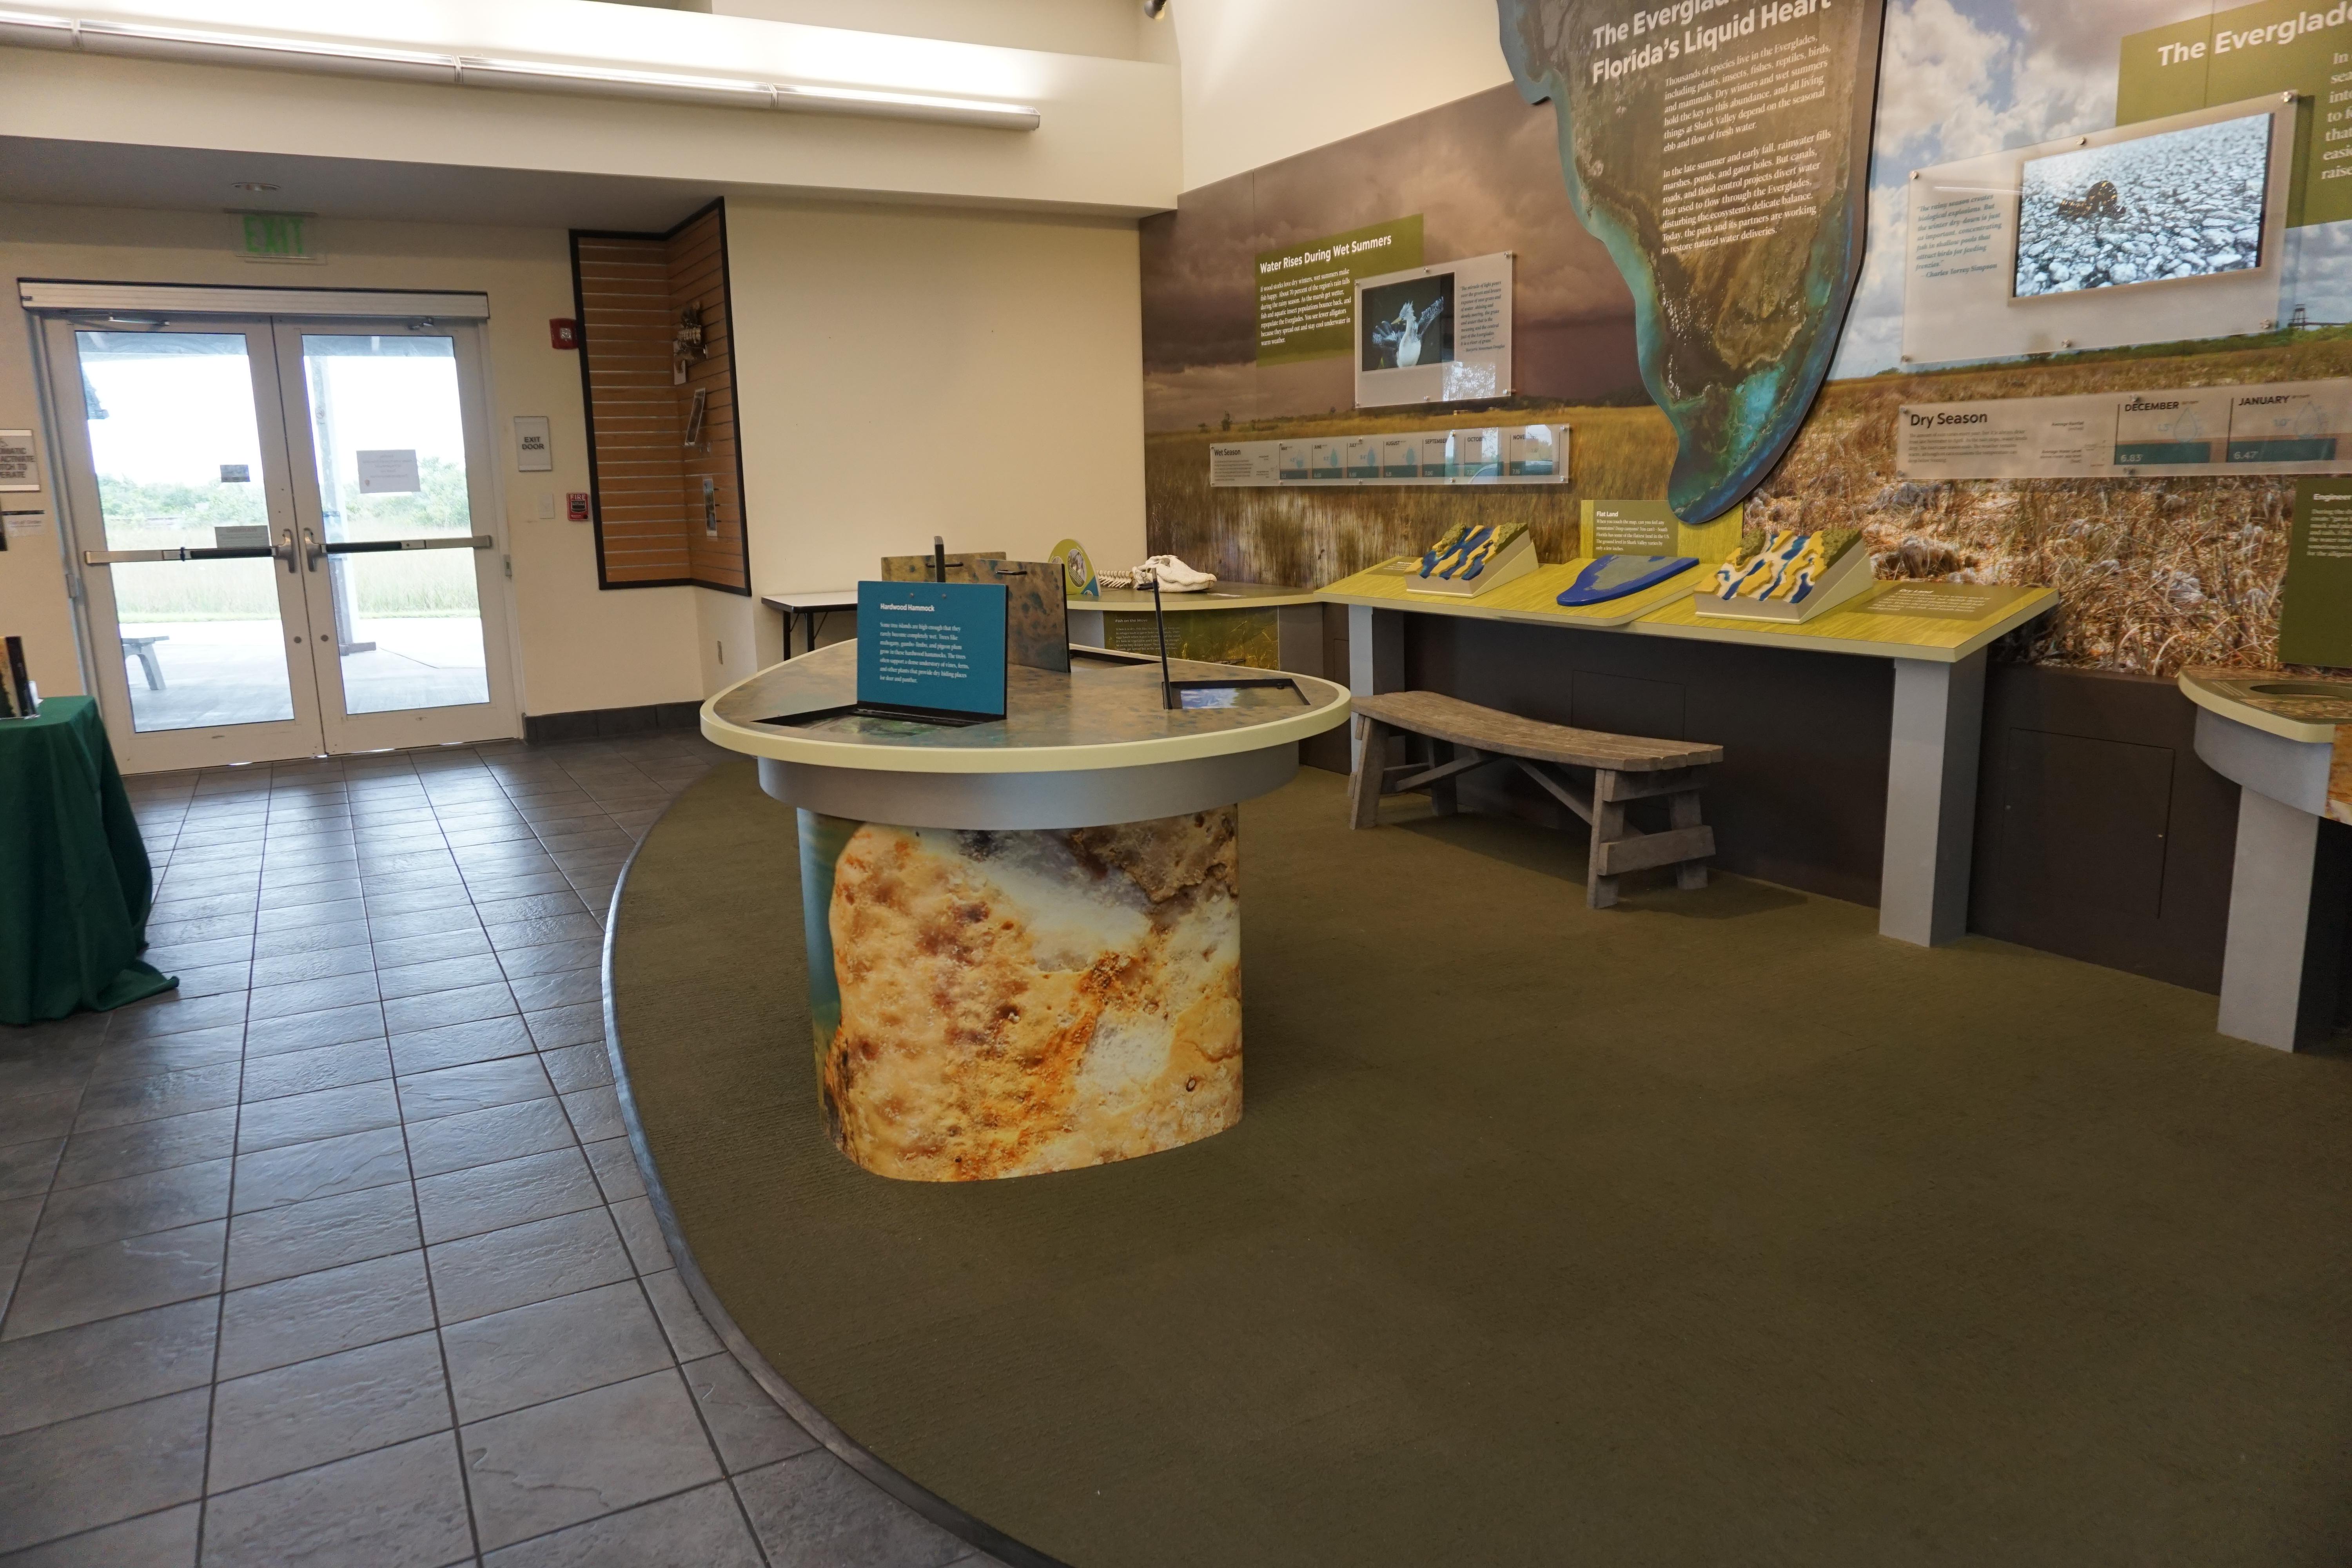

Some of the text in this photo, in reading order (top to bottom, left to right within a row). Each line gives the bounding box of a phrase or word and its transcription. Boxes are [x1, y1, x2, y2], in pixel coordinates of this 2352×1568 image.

[1593, 22, 1628, 49] The
[1593, 38, 1679, 83] Florida's
[1685, 8, 1755, 53] Liquid
[1665, 69, 1700, 87] Thousands
[1702, 65, 1710, 75] of
[1710, 59, 1735, 75] species
[1737, 55, 1750, 65] live
[1760, 47, 1773, 57] the
[1774, 34, 1818, 54] Everglades,
[2158, 42, 2206, 66] The
[2333, 52, 2349, 65] In
[1664, 44, 1831, 100] including plants, insects, fishes, reptiles, birds,
[1664, 60, 1828, 114] and mammals. Dry winters and wet summers
[1664, 114, 1679, 126] hold
[1679, 112, 1691, 122] the
[1692, 109, 1705, 119] key
[1715, 100, 1728, 112] this
[1730, 91, 1771, 108] abundance,
[1773, 83, 1788, 95] and
[1789, 80, 1799, 91] all
[1801, 75, 1824, 88] living
[1664, 128, 1685, 139] things
[1686, 124, 1693, 134] at
[1694, 118, 1714, 131] Shark
[1716, 113, 1737, 125] Valley
[1738, 103, 1765, 120] depend
[1778, 98, 1791, 108] the
[1792, 87, 1825, 104] seasonal
[2327, 113, 2343, 122] to
[1663, 122, 1757, 152] ebb and flow of fresh water.
[1663, 130, 1831, 178] In the late summer and early fall, rainwater fills
[2323, 144, 2352, 160] easi
[244, 216, 303, 254] EXIT
[1670, 243, 1693, 254] restore
[1694, 236, 1718, 250] natural
[1720, 234, 1740, 244] water
[1741, 226, 1777, 240] deliveries.
[1260, 235, 1392, 274] Water Rises During Wet Summers
[1321, 271, 1338, 279] summers
[2125, 401, 2180, 412] DECEMBER
[2238, 395, 2291, 406] JANUARY
[1911, 412, 1988, 428] Dry Season
